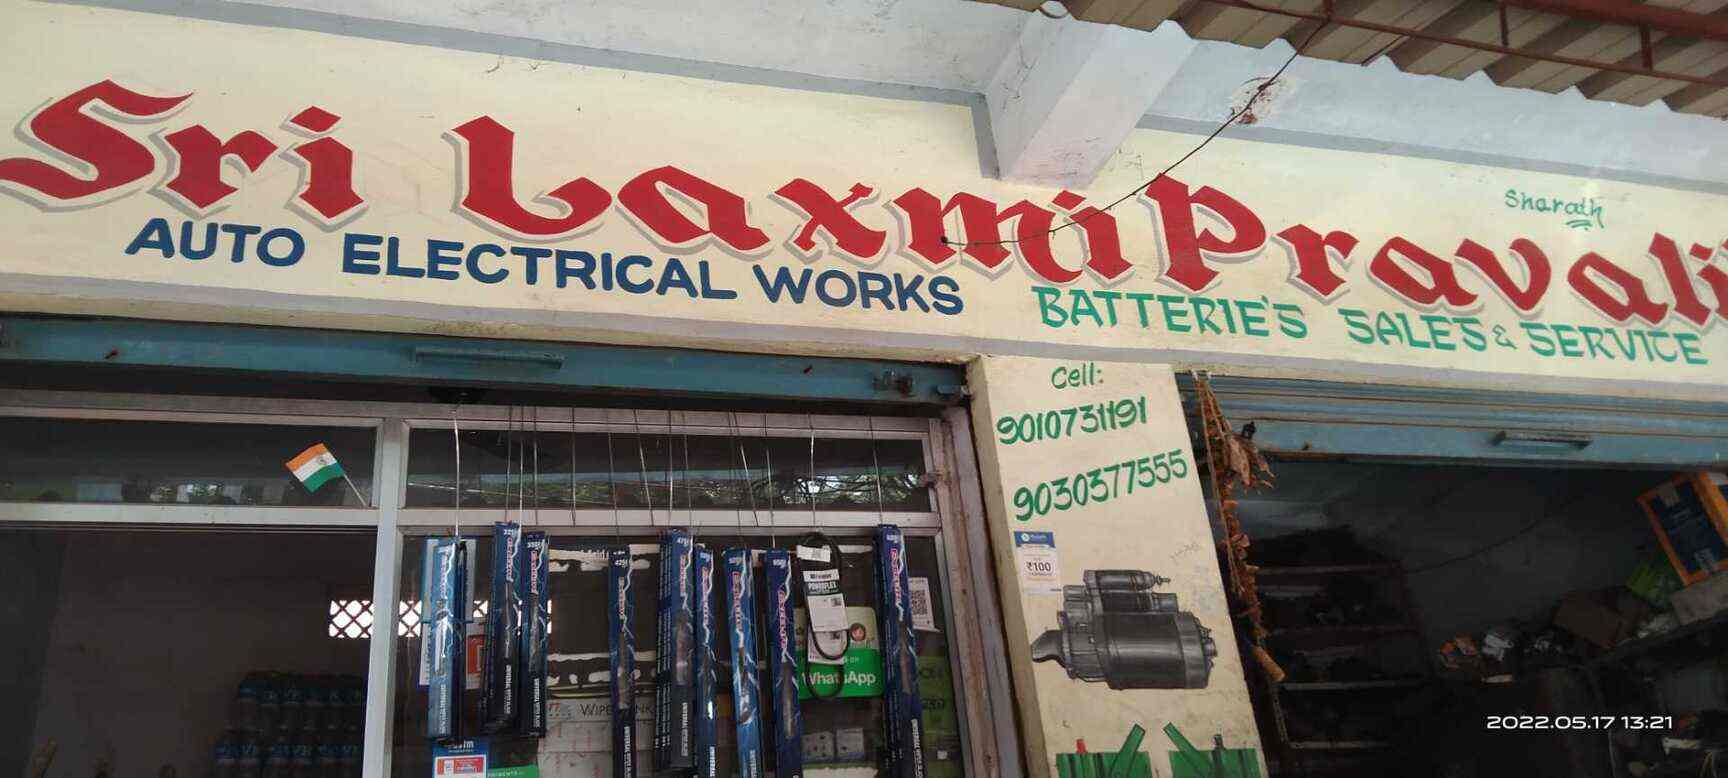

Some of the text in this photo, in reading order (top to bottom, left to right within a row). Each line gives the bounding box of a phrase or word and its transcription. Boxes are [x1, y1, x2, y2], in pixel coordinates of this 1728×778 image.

[0, 80, 364, 219] Sri
[453, 115, 1133, 283] Laxmi
[125, 218, 964, 315] AUTO ELECTRICAL WORKS
[1338, 308, 1487, 352] SALES
[1491, 324, 1518, 350] &
[1519, 321, 1709, 365] SERVICE
[1050, 361, 1104, 391] Cell:
[996, 396, 1148, 446] 9010731191
[1013, 449, 1189, 522] 9030377555
